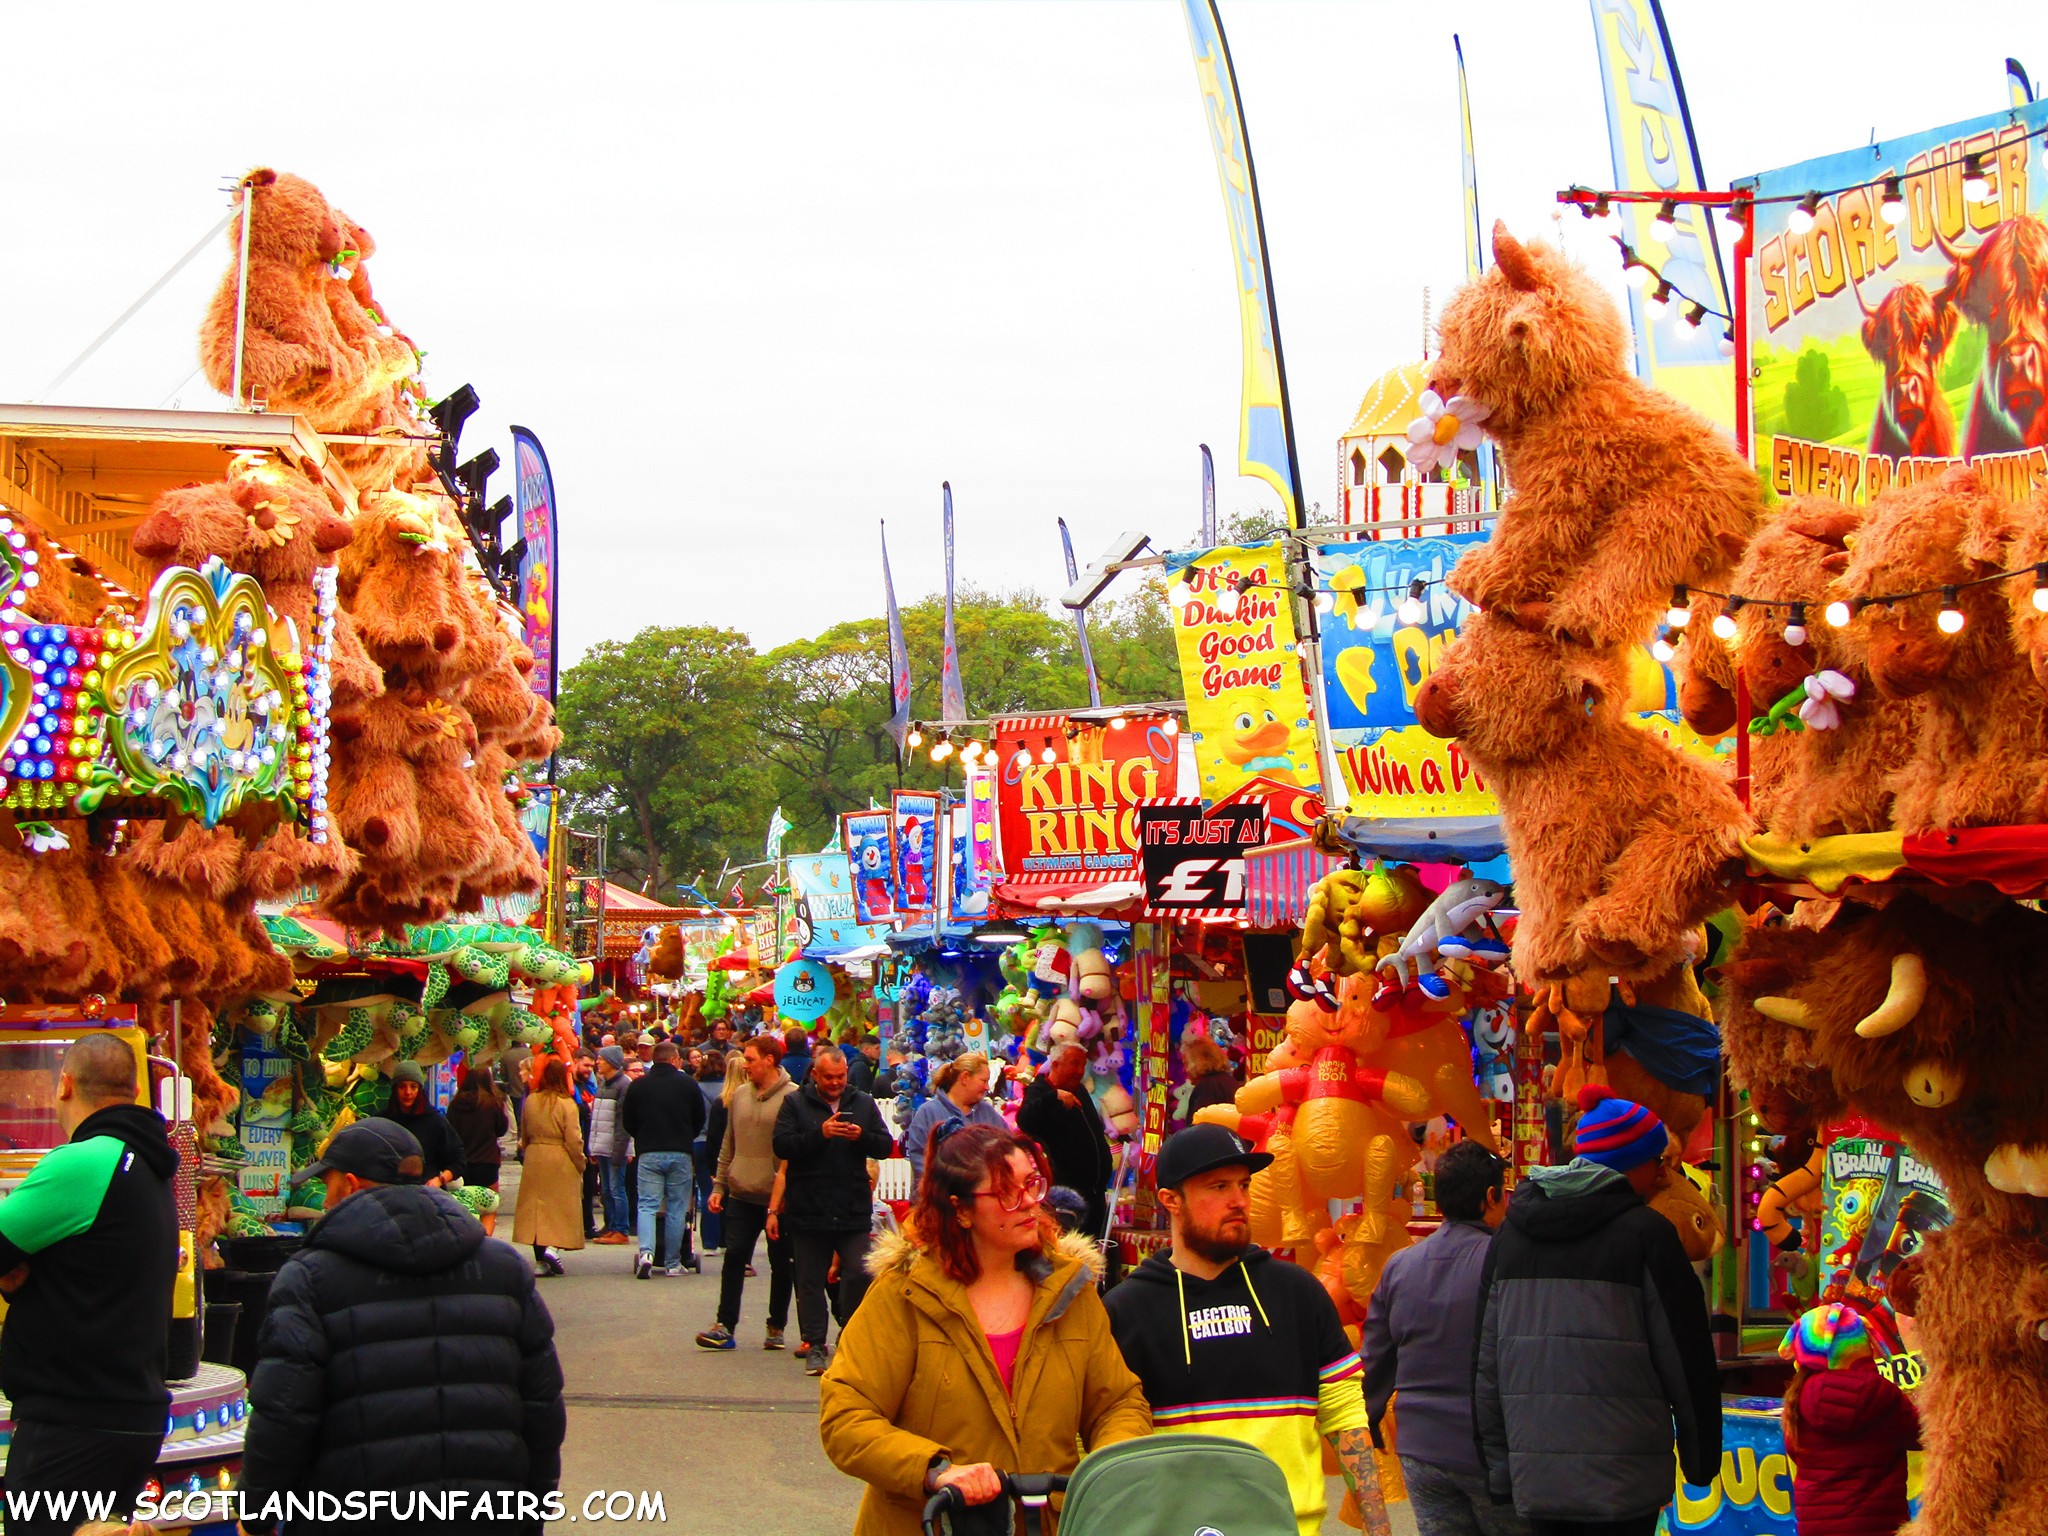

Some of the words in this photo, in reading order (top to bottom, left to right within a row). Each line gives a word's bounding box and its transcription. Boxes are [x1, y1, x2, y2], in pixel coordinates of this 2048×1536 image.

[1759, 167, 1900, 334] SCORE
[1904, 122, 2031, 253] OVER
[1772, 434, 1861, 506] EVERY
[1188, 564, 1241, 593] It's
[1249, 566, 1268, 586] a
[1183, 591, 1281, 627] Dukin'
[1369, 552, 1474, 643] Luck
[1199, 624, 1276, 664] Good
[1202, 663, 1283, 697] Game
[1017, 755, 1160, 812] KING
[1346, 745, 1416, 796] Win
[1420, 758, 1446, 795] a
[1145, 820, 1181, 846] IT'S
[1182, 819, 1236, 846] JUST
[1236, 818, 1261, 845] A!
[1022, 855, 1082, 872] ULTIMATE
[1084, 853, 1133, 869] GADGET
[1157, 858, 1246, 902] £1
[758, 934, 777, 951] BIG
[243, 1058, 261, 1078] TO
[1317, 1068, 1347, 1082] Pooh
[248, 1125, 283, 1146] EVERY
[244, 1149, 287, 1170] PLAYER
[1832, 1151, 1891, 1179] BRAIN
[243, 1174, 275, 1191] WINS
[1189, 1304, 1251, 1326] ELECTRIC
[1191, 1318, 1252, 1341] CALLBOY
[1673, 1446, 1798, 1524] DUC
